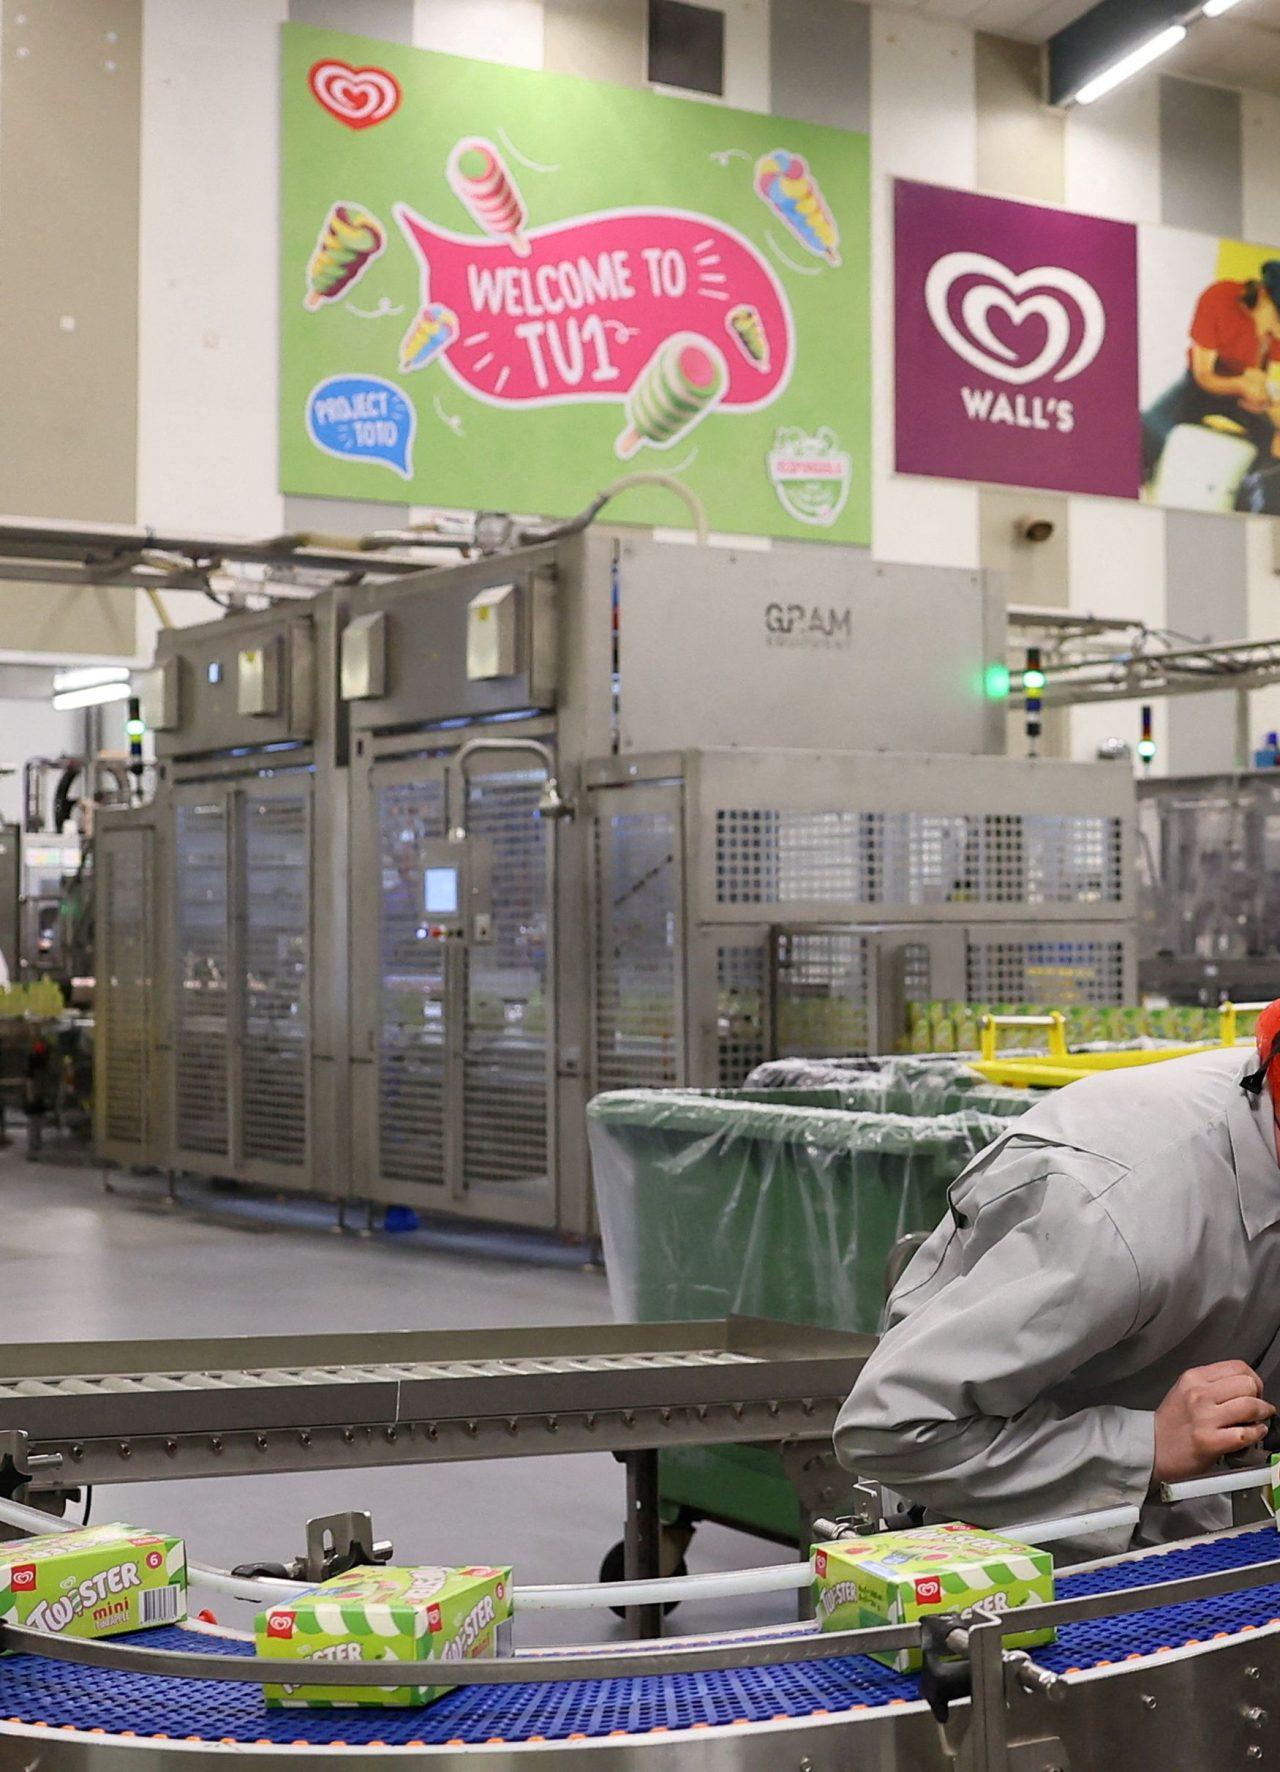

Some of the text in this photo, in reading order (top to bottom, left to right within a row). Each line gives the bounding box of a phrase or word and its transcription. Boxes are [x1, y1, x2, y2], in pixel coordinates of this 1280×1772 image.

[467, 248, 687, 316] WELCOME TO
[514, 314, 620, 390] TU1
[315, 392, 388, 425] PROJECT
[960, 386, 1074, 432] WALL'S
[149, 1553, 159, 1566] 6
[25, 1561, 142, 1632] TWISTER
[92, 1596, 129, 1621] mini
[820, 1581, 857, 1617] TWISTER
